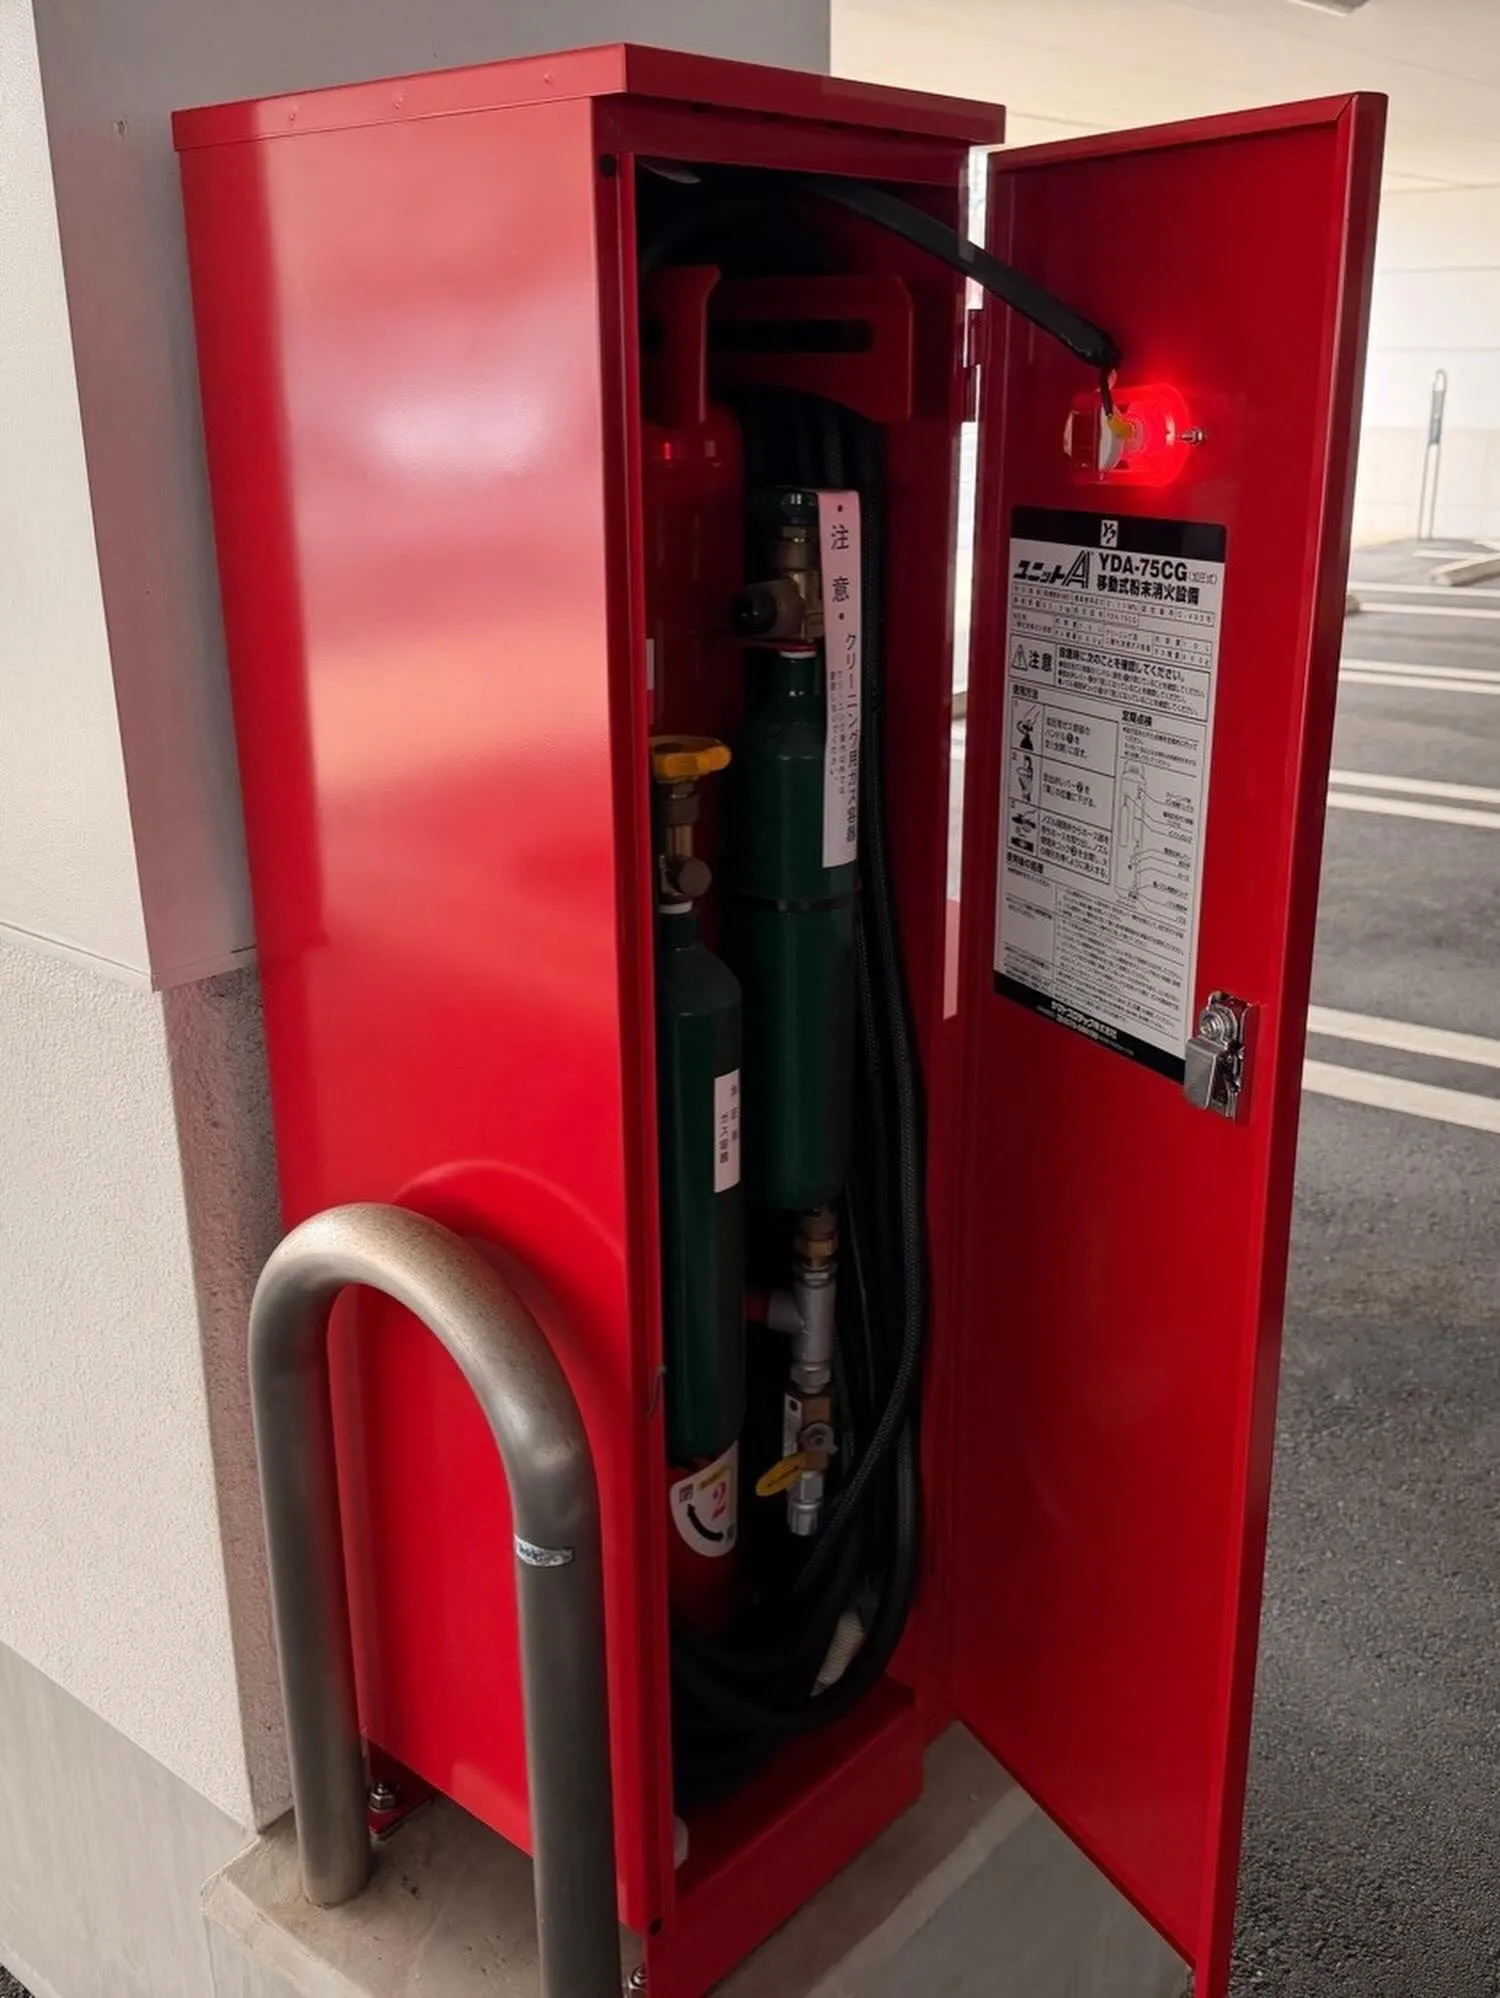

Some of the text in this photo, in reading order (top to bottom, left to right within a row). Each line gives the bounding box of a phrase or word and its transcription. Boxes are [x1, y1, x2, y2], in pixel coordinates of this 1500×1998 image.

[1099, 552, 1187, 583] YDA-75CG
[1097, 575, 1200, 605] 移動式粉末消火設備
[1028, 649, 1053, 672] 注意
